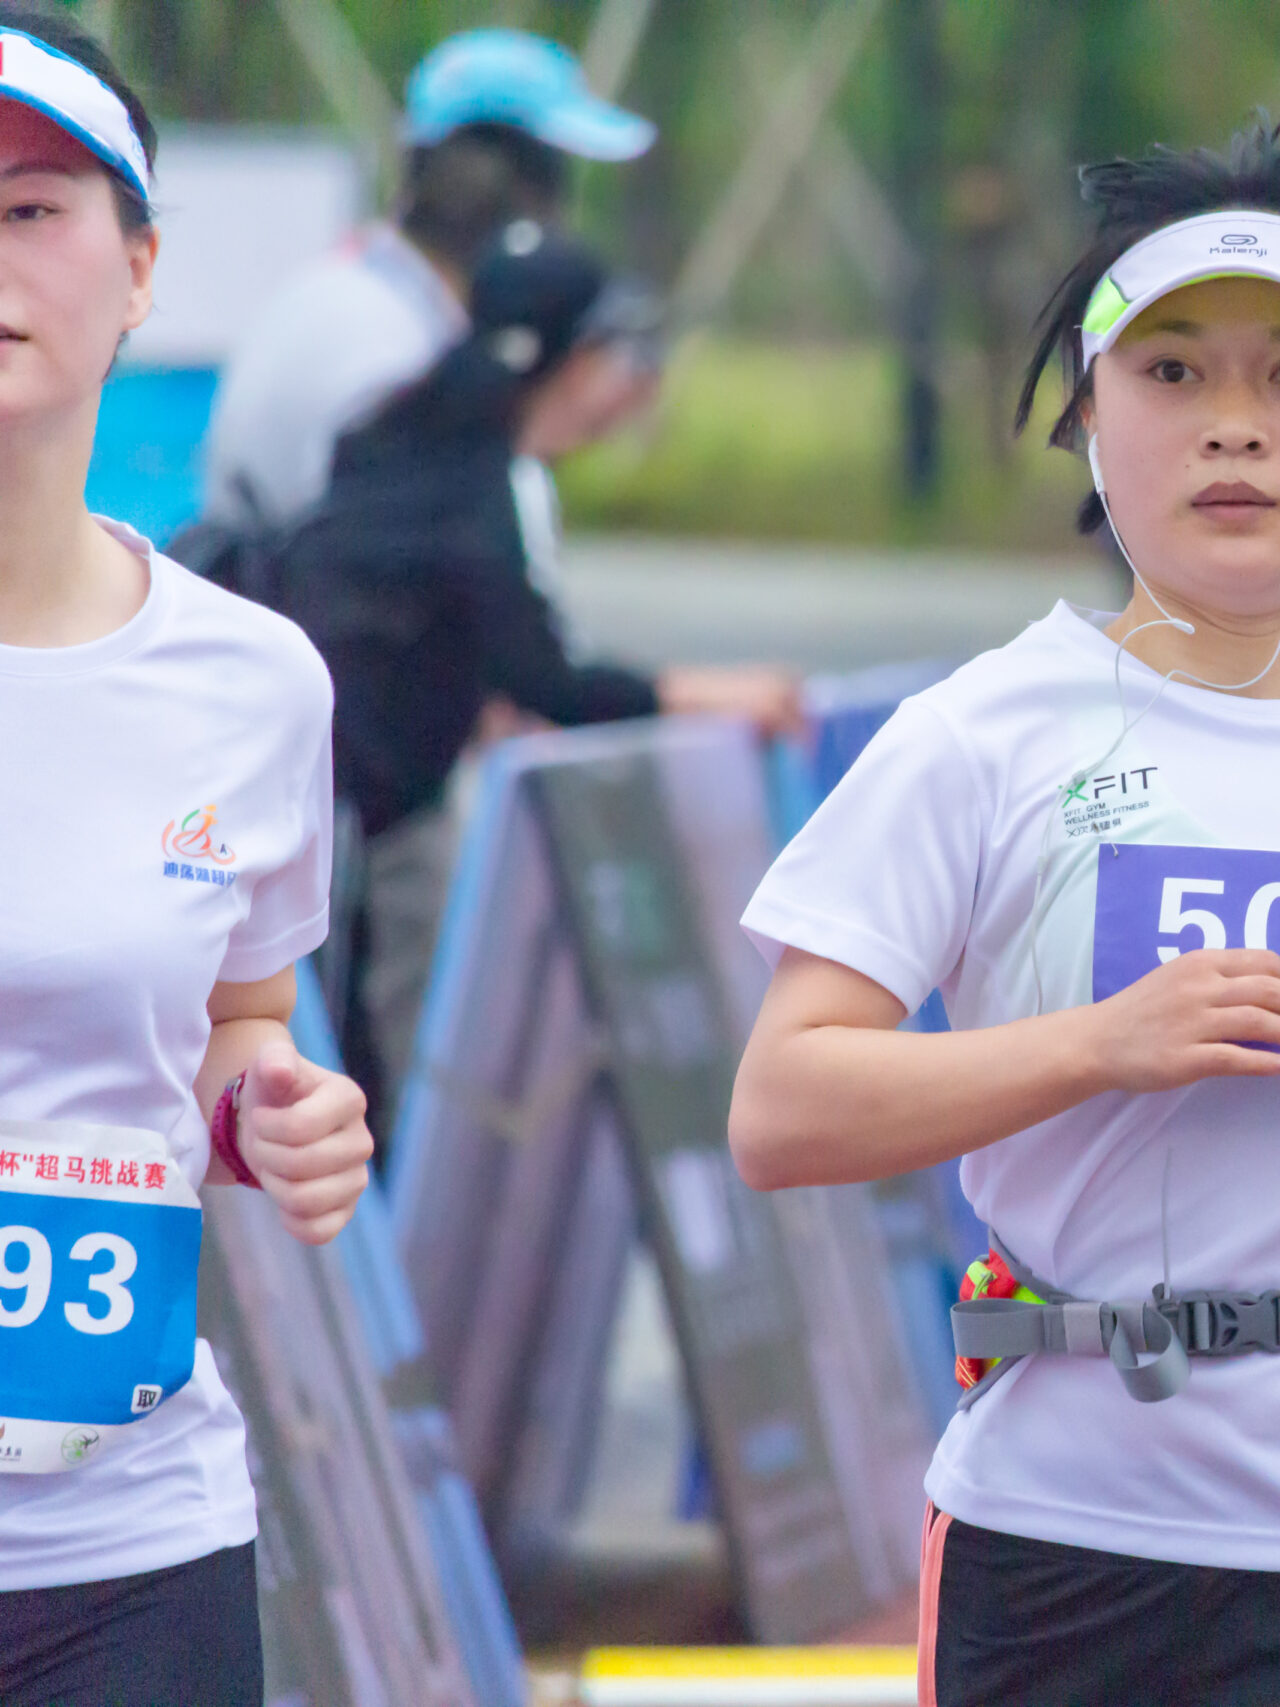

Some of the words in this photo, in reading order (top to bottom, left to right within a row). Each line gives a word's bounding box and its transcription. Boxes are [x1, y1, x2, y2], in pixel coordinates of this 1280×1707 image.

[1209, 246, 1268, 257] Kalenji
[1063, 809, 1081, 818] XFIT
[1086, 802, 1106, 812] GYM
[1064, 810, 1111, 826] WELLNESS
[1113, 801, 1150, 815] FITNESS
[0, 1225, 138, 1335] 93
